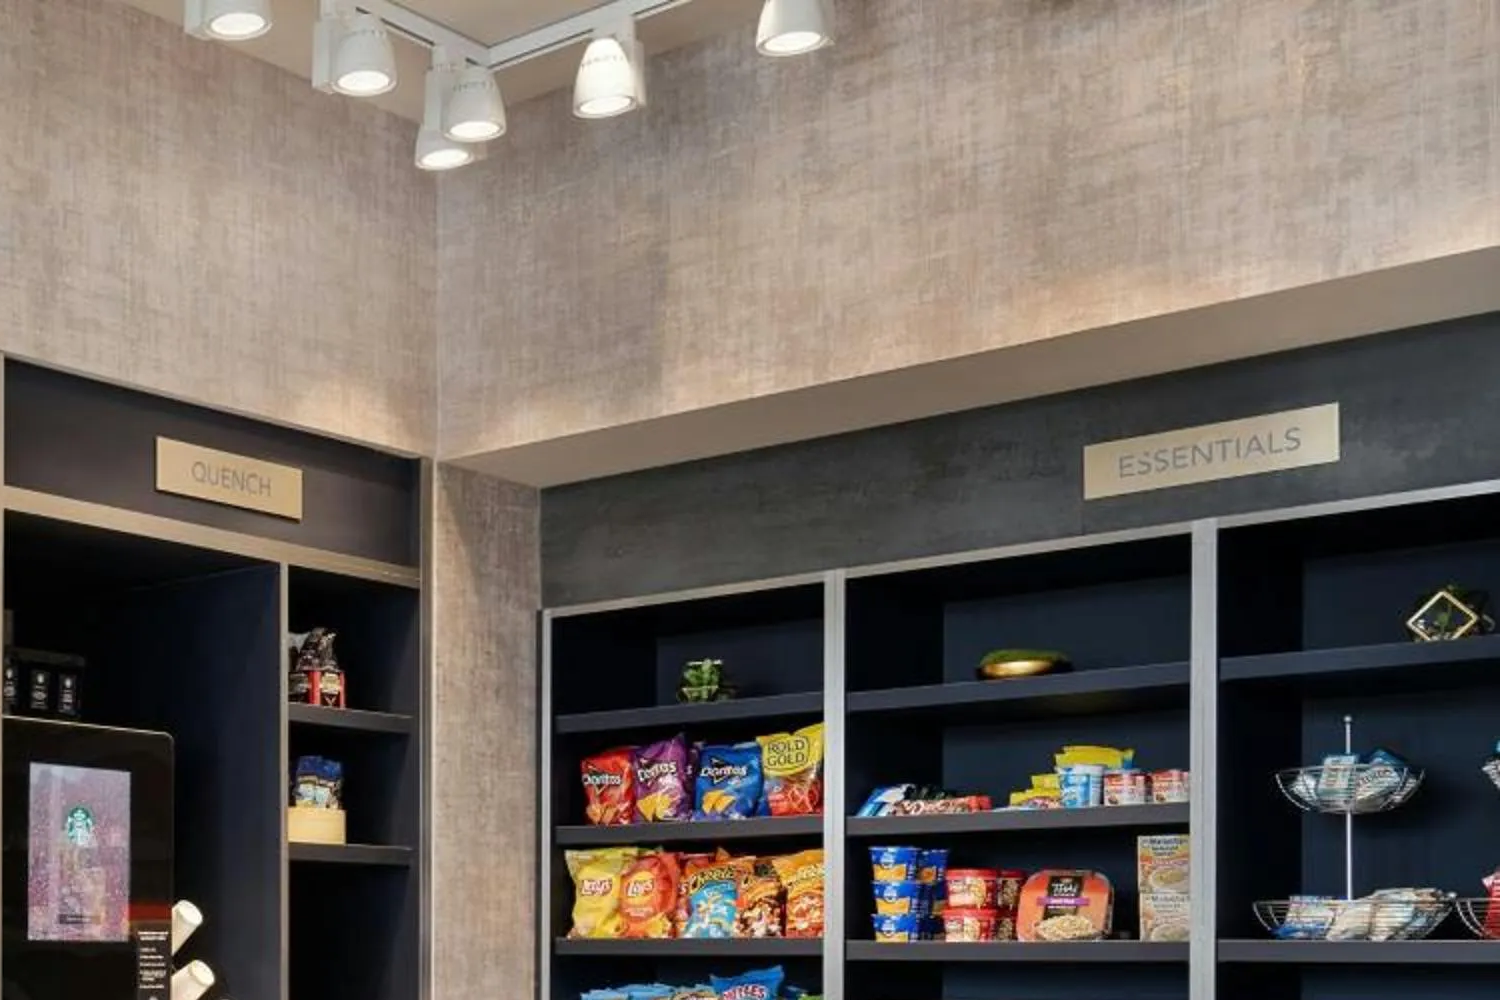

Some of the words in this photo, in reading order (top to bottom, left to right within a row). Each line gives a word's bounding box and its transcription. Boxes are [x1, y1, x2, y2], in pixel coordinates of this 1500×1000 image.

[1117, 426, 1302, 479] ESSENTIALS
[190, 461, 272, 497] QUENCH
[767, 739, 806, 754] ROLD
[766, 752, 806, 768] GOLD
[582, 773, 622, 786] Doritos
[638, 761, 677, 782] Doritos
[700, 765, 748, 778] Doritos
